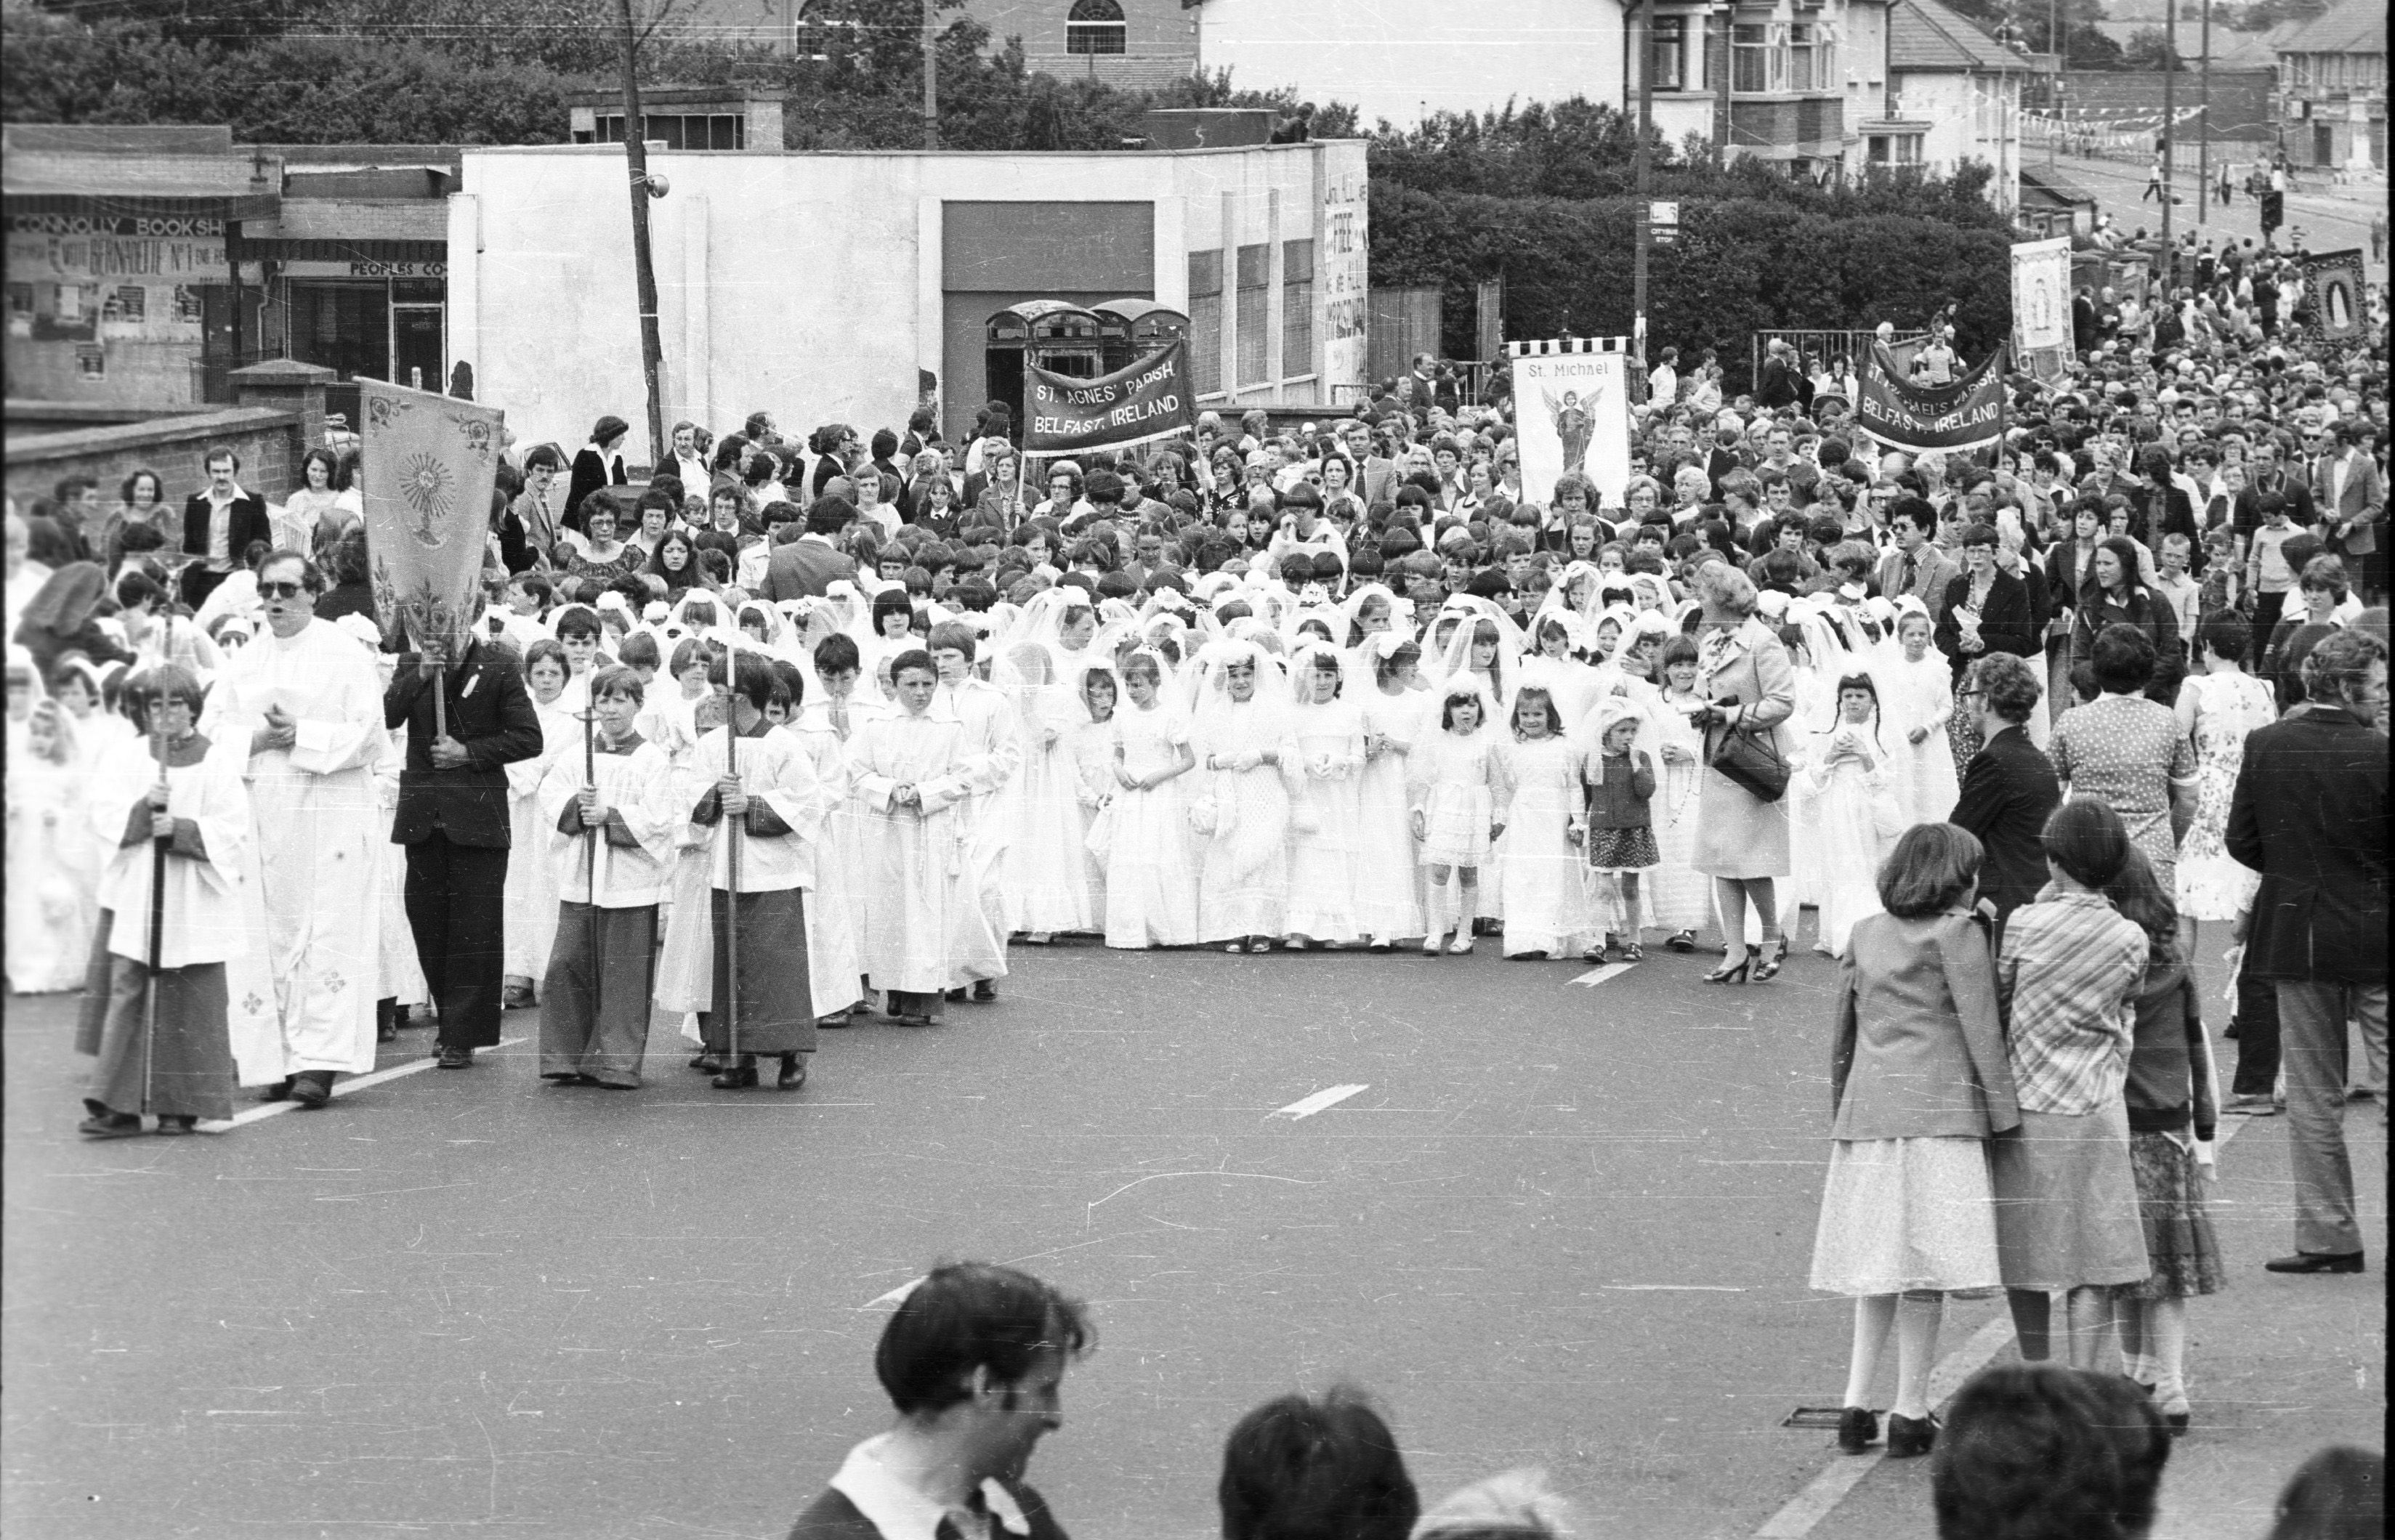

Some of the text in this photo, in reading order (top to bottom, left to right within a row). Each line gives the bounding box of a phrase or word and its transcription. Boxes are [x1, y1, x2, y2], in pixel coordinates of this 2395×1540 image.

[14, 216, 121, 234] CONNOLLY
[350, 263, 413, 275] PEOPLES
[1529, 362, 1609, 377] St. Michael
[1037, 360, 1176, 405] ST. AGNES' PARISH
[1111, 394, 1179, 426] IRELAND
[1934, 402, 1999, 433] IRELAND
